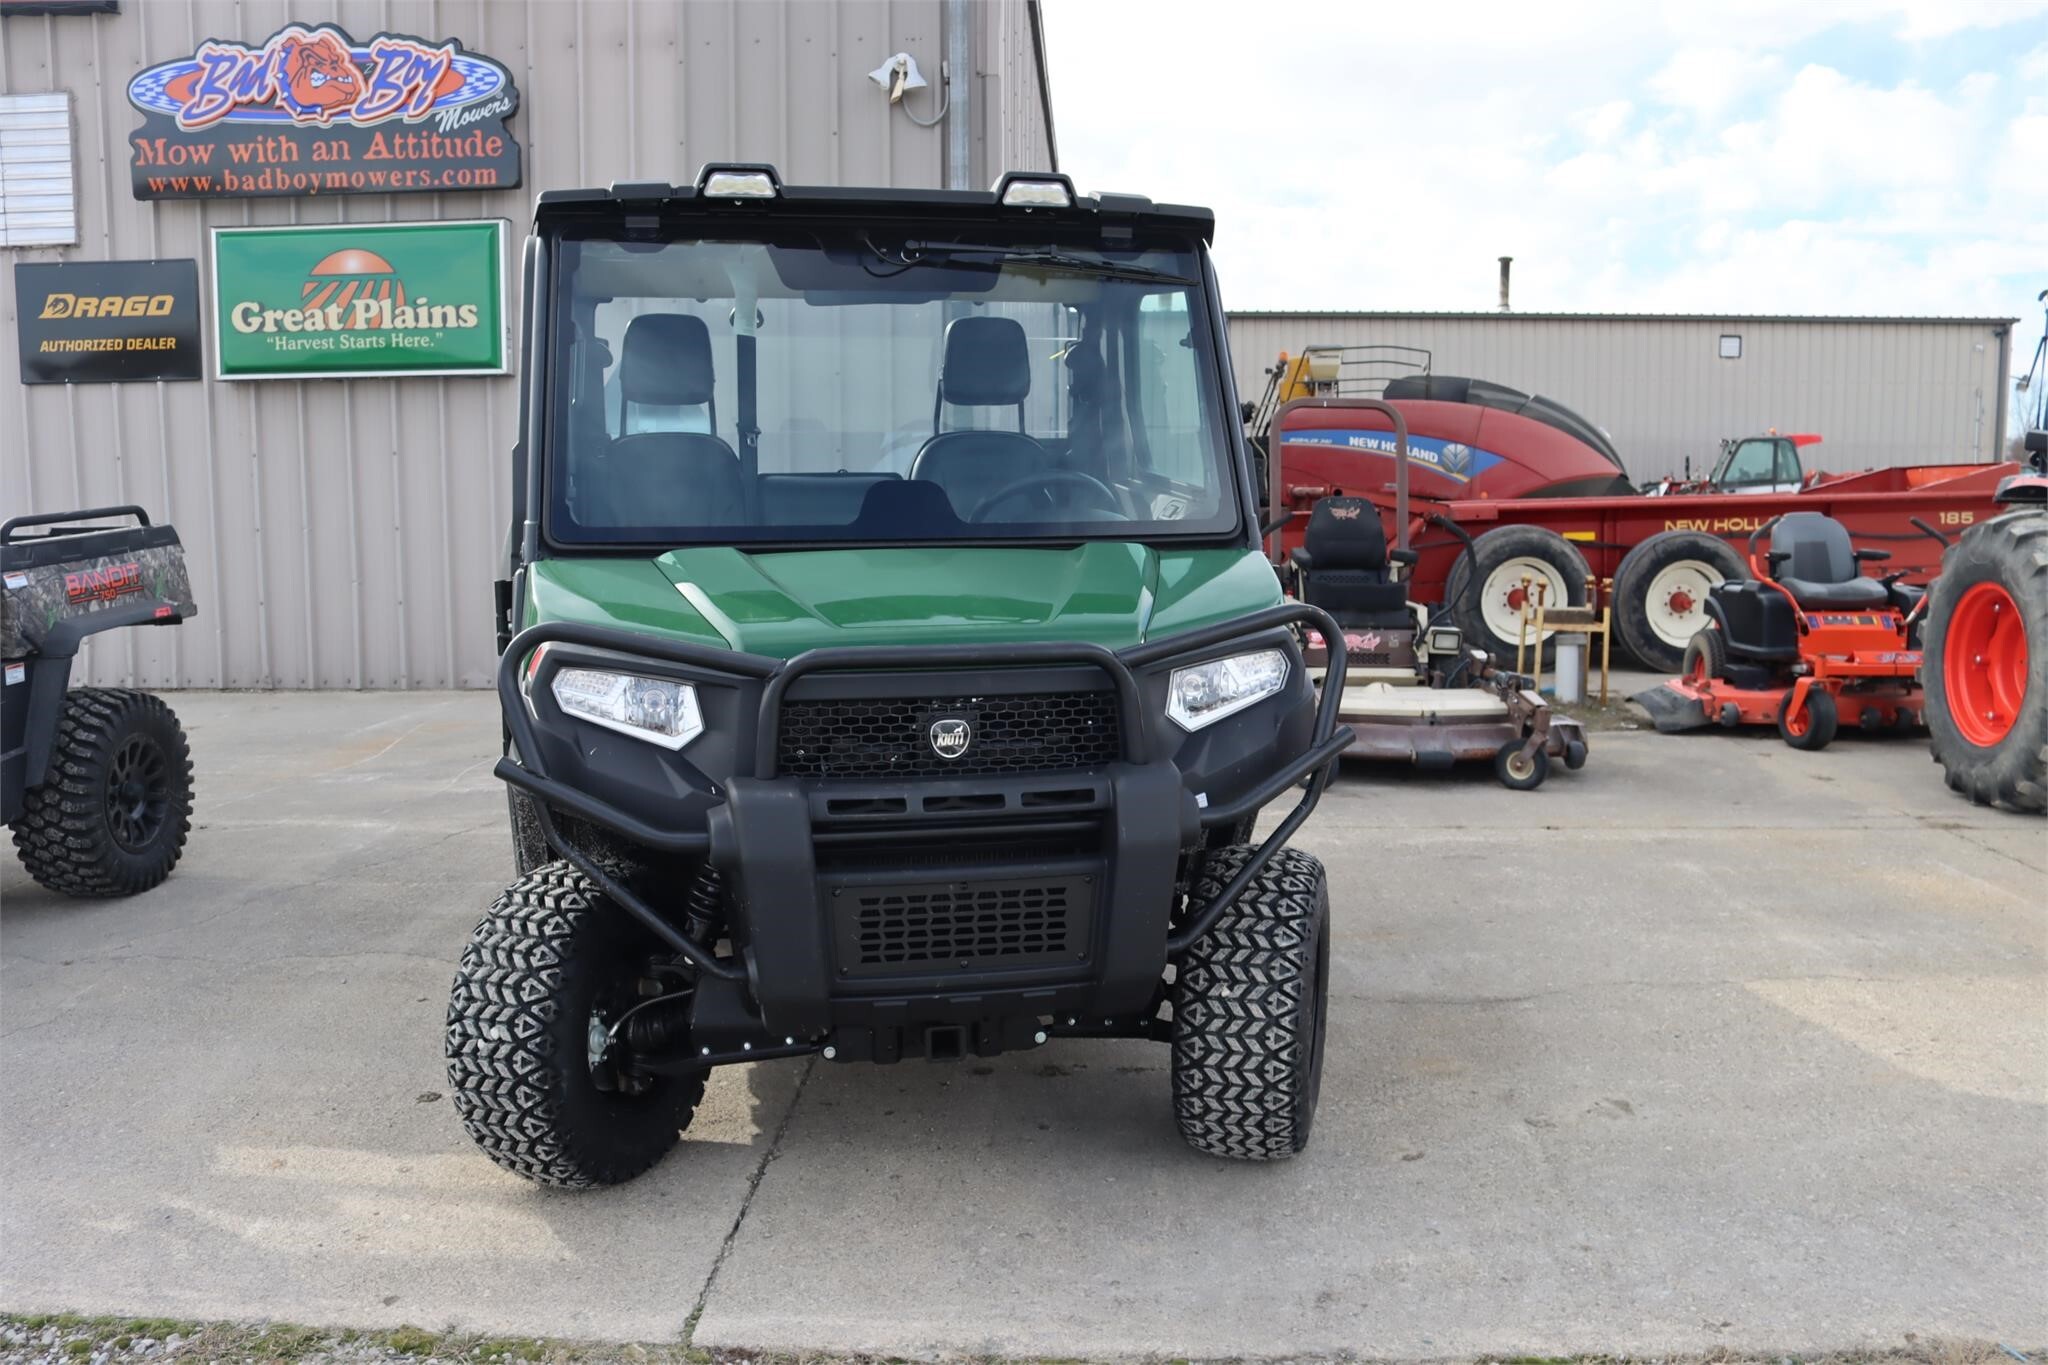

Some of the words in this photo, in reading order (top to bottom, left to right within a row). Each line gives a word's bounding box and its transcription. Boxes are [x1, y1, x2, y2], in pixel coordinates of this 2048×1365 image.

[181, 48, 276, 120] Bad
[354, 46, 447, 118] Boy
[435, 97, 512, 133] Mowers
[135, 138, 215, 166] Mow
[228, 135, 298, 164] with
[312, 140, 351, 161] an
[363, 130, 503, 160] Attitude
[148, 167, 497, 194] www.badboymowers.com
[38, 293, 175, 319] DRAGO
[231, 301, 345, 333] Great
[352, 297, 478, 331] Plains
[40, 338, 123, 352] AUTHORIZED
[126, 337, 177, 350] DEALER
[340, 334, 386, 349] Starts
[1349, 436, 1379, 449] NEW
[1381, 440, 1438, 463] HOLAND
[1664, 519, 1710, 532] NEW
[1714, 517, 1761, 531] HOLL
[1939, 511, 1974, 525] 185
[64, 562, 139, 596] BANDIT
